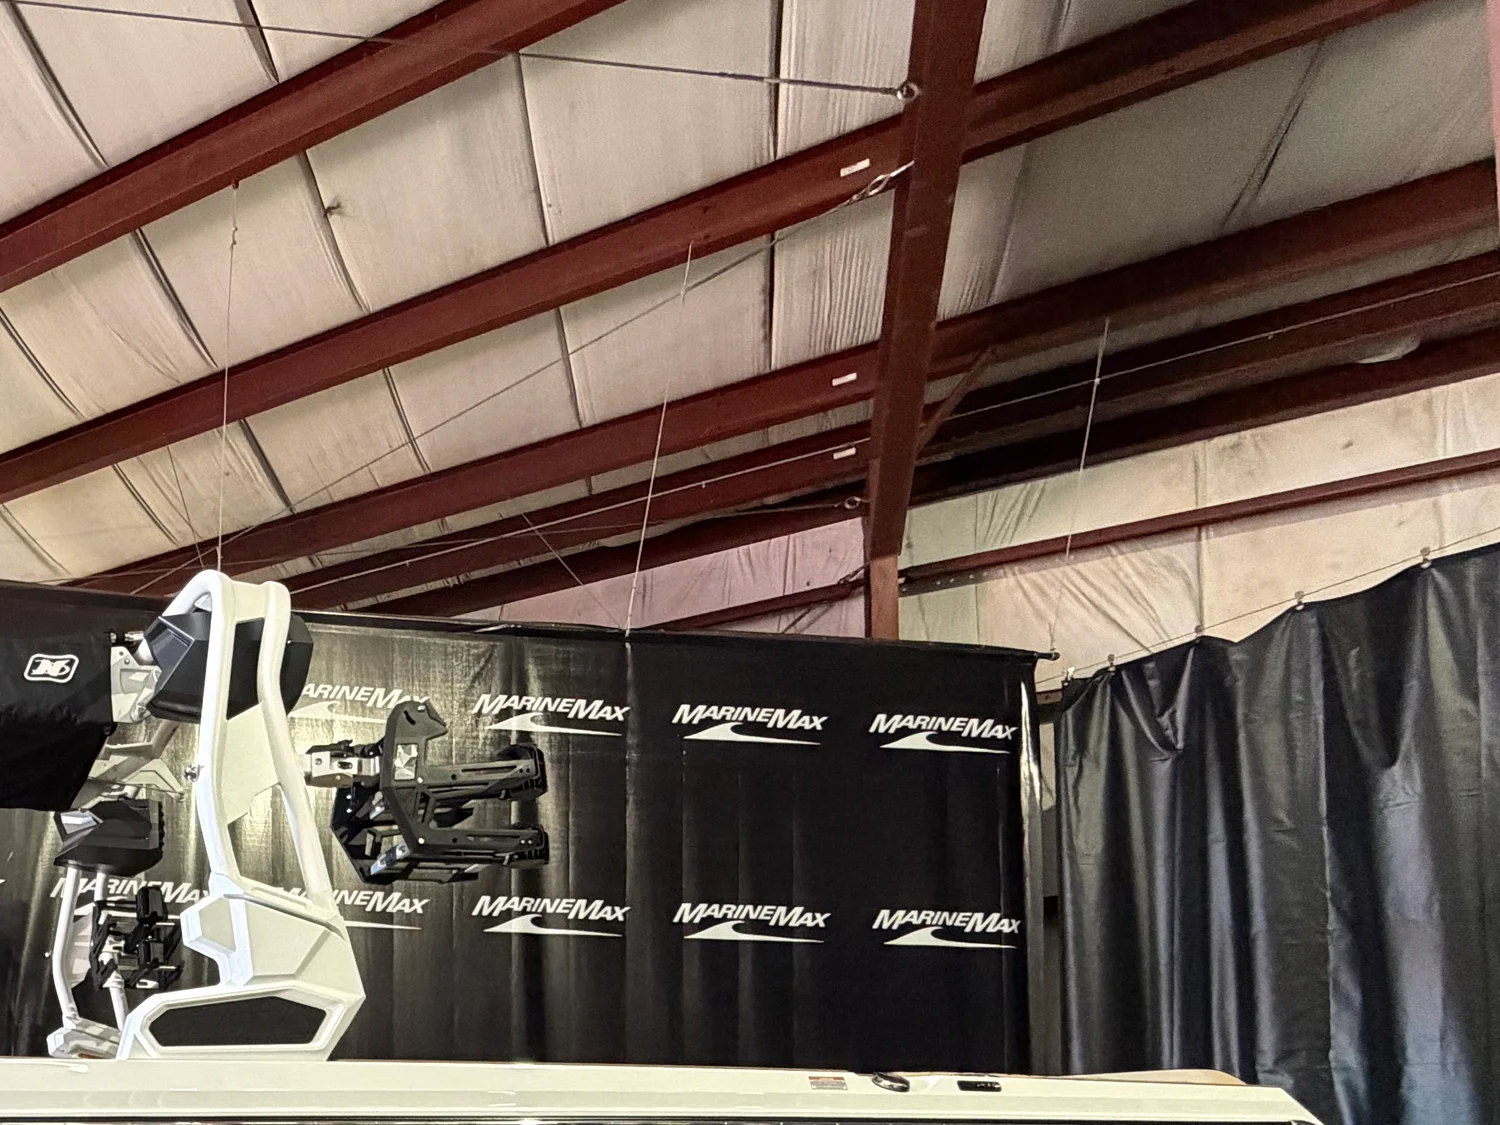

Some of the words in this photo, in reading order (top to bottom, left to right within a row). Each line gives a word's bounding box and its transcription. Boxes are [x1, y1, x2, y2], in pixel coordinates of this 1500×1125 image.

[472, 693, 629, 722] MARINEMAX
[672, 704, 827, 730] MARINEMAX
[869, 713, 1017, 742] MARINEMAX
[472, 895, 630, 922] MARINEMAX
[673, 903, 831, 930] MARINEMAX
[873, 909, 1020, 934] MARINEMAX
